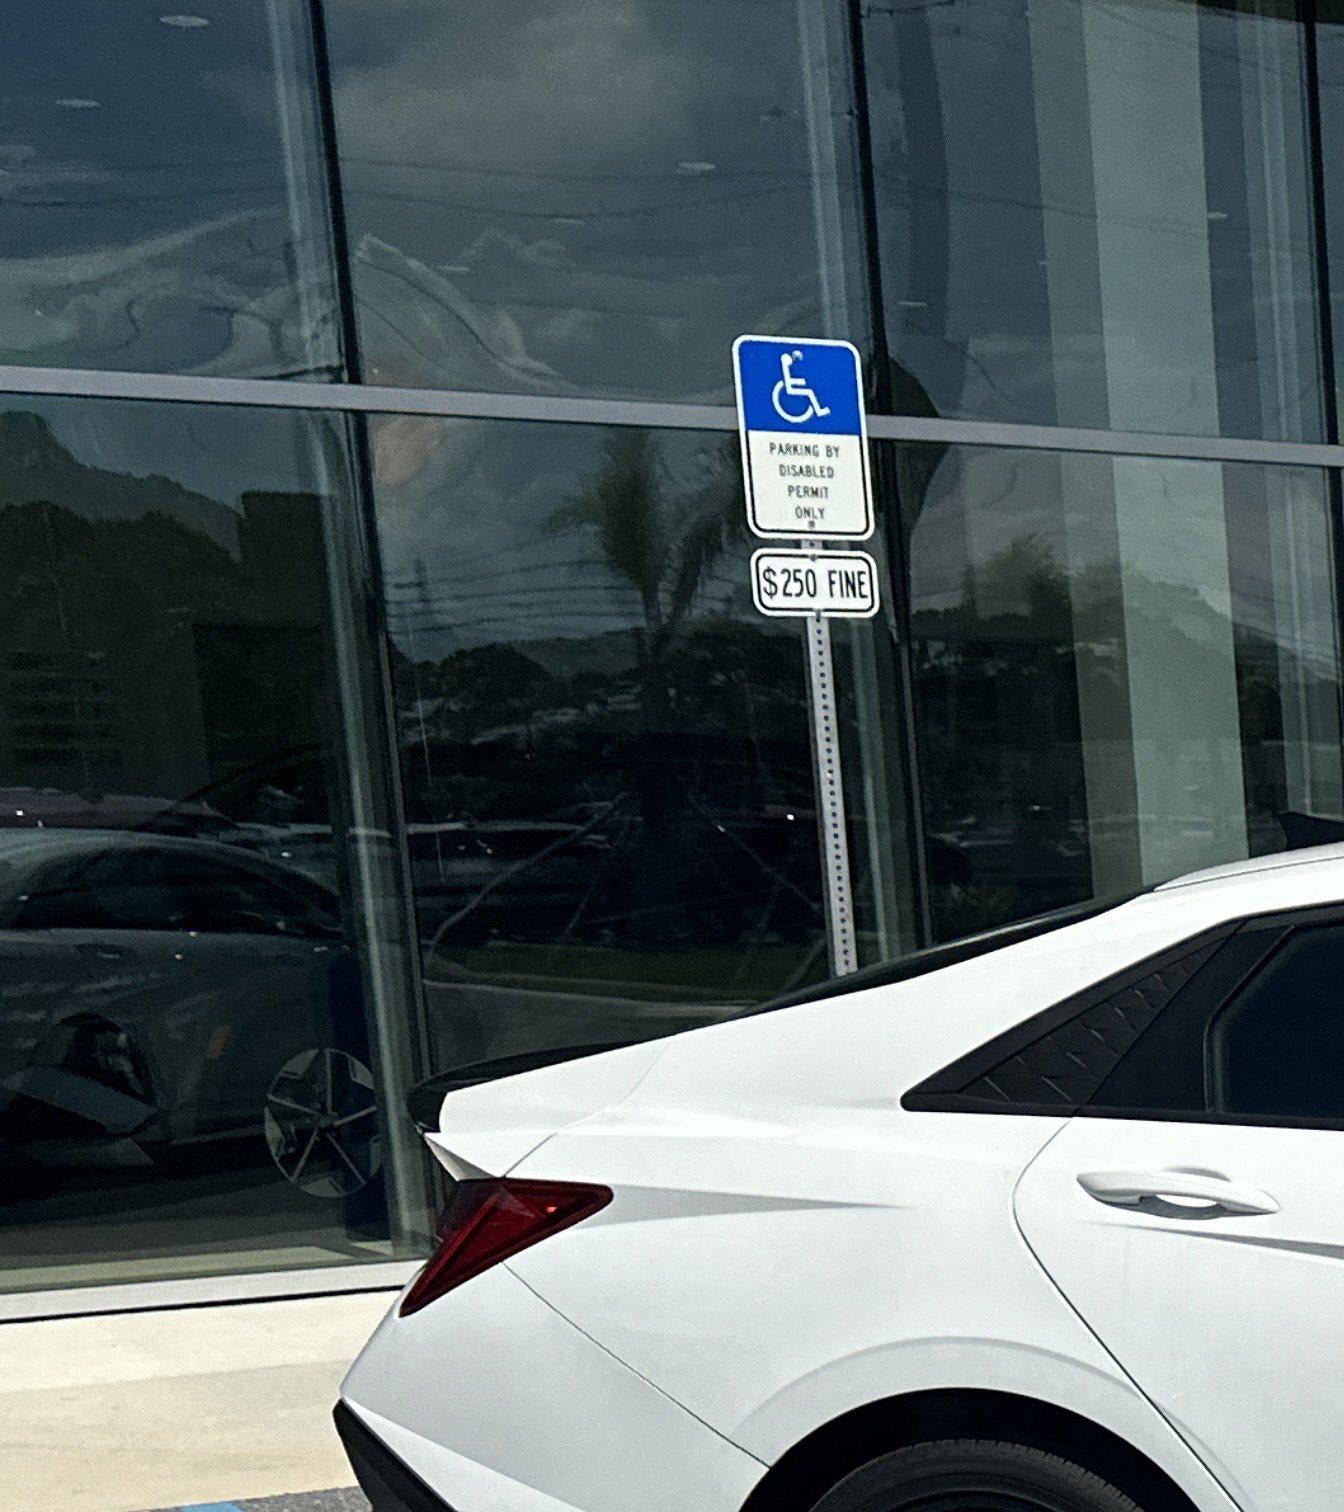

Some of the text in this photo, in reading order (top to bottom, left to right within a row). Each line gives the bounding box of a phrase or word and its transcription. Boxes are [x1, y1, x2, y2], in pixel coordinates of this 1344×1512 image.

[769, 441, 840, 458] PARKING BY
[779, 463, 834, 479] DISABLED
[787, 484, 829, 499] PERMIT
[795, 505, 825, 519] ONLY
[762, 565, 869, 600] $250 FINE
